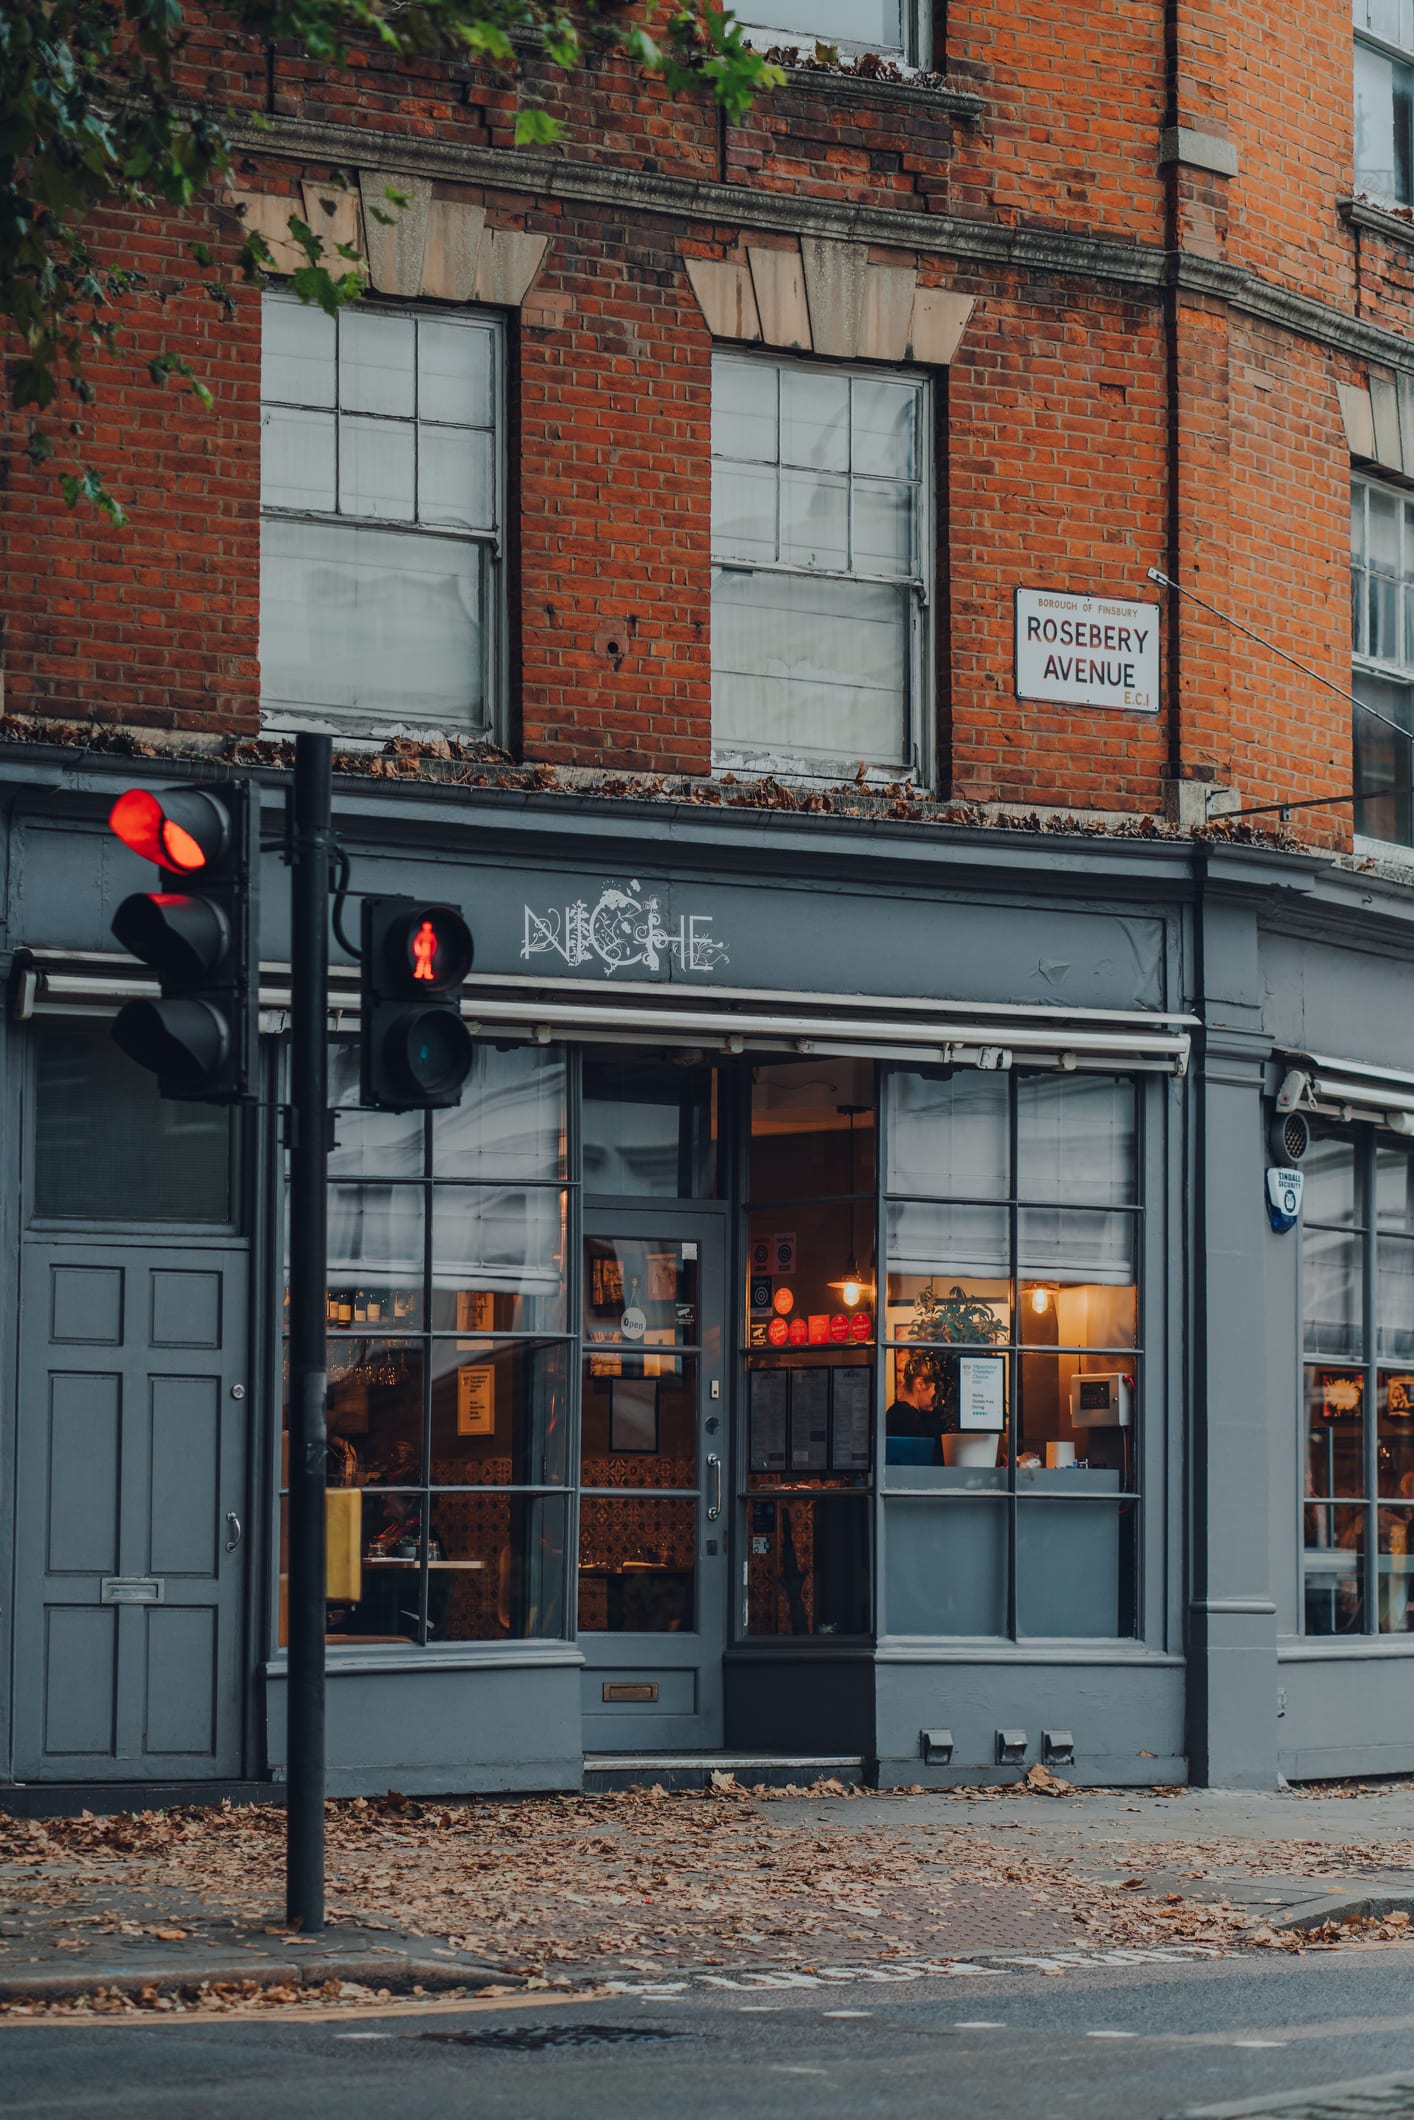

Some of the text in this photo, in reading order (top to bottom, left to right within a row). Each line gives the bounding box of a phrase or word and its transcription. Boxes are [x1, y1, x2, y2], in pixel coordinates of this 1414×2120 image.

[1038, 598, 1138, 618] BOROUGH OF FINSBURY
[1027, 615, 1149, 654] ROSEBERY
[1043, 654, 1136, 688] AVENUE
[520, 882, 729, 976] NICHE
[1279, 1180, 1301, 1190] SECURITY
[623, 1317, 644, 1330] Open
